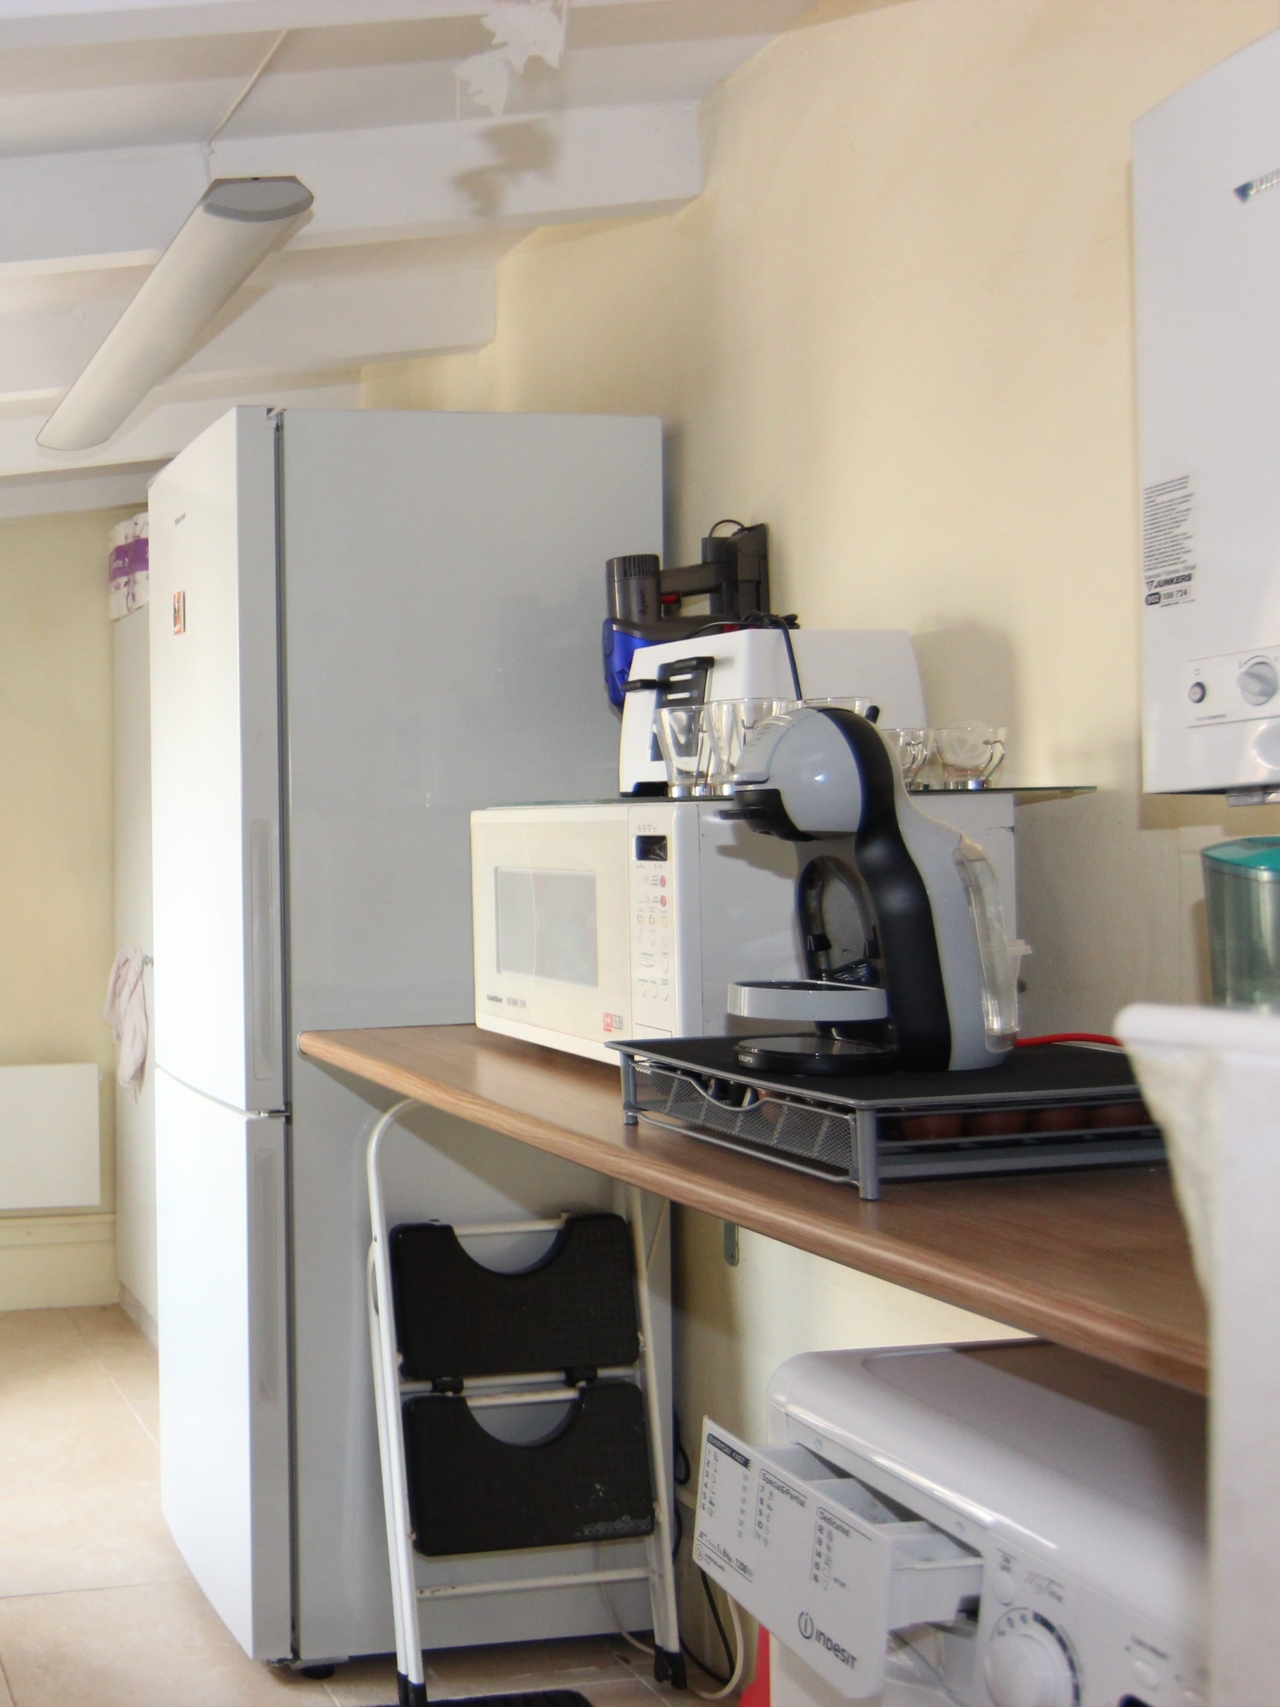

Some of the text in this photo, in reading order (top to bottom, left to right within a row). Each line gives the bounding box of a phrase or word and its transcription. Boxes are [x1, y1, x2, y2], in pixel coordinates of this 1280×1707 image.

[1154, 573, 1192, 589] JUNKERS
[708, 1435, 746, 1465] EVERYDAY FAST
